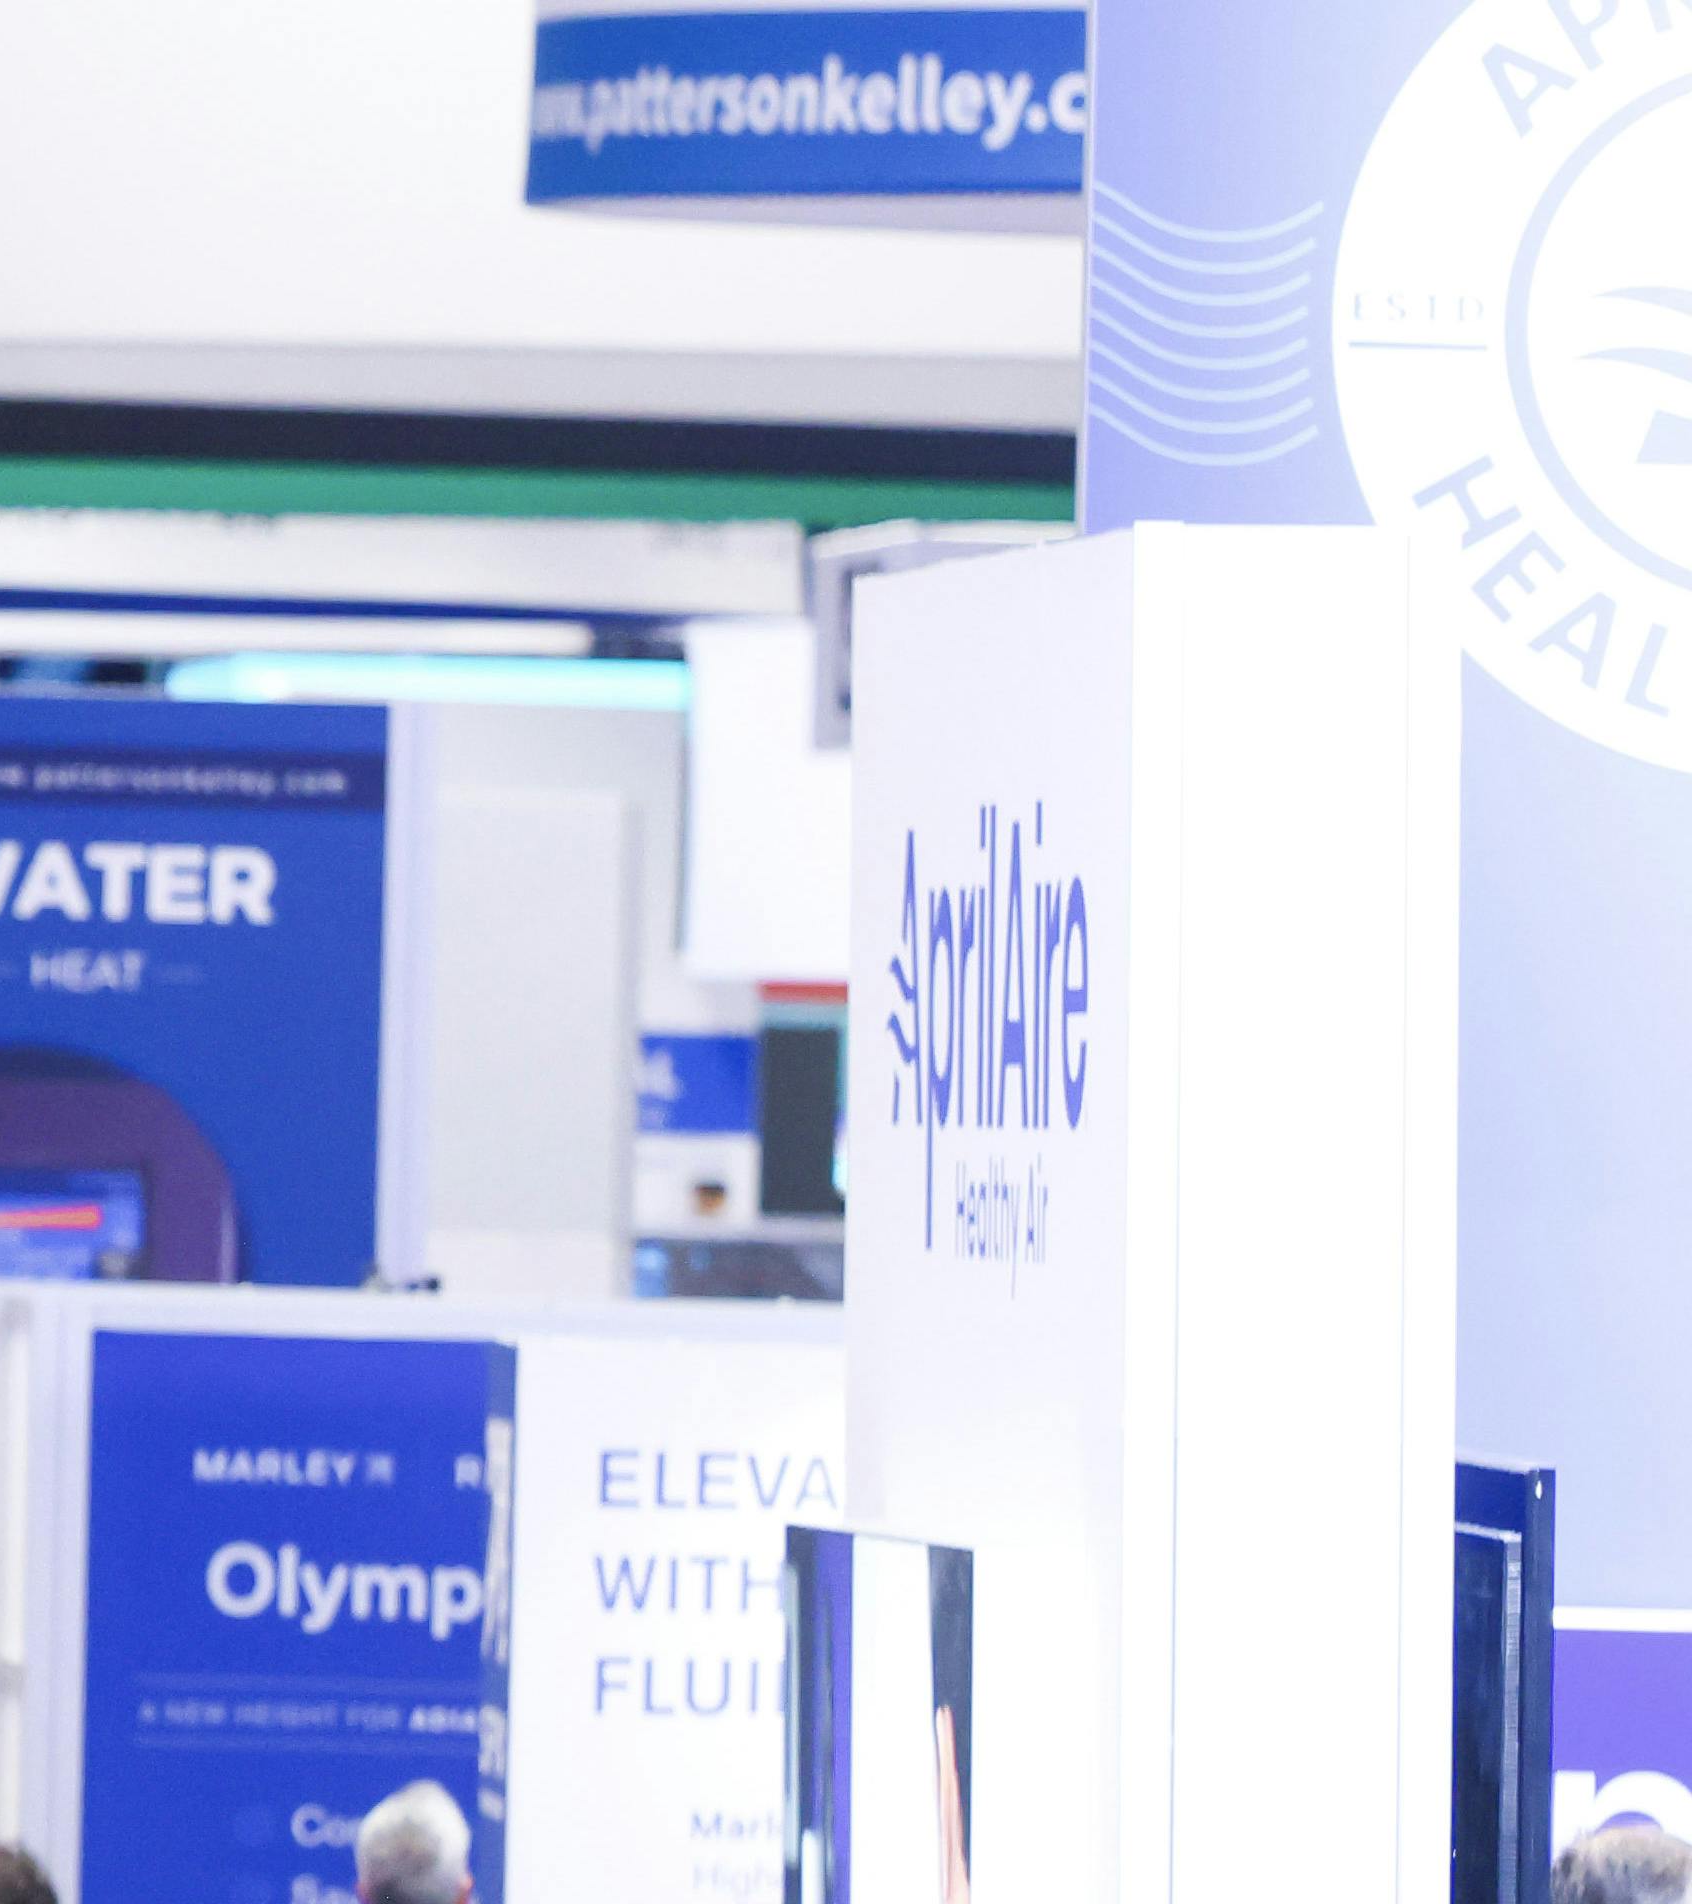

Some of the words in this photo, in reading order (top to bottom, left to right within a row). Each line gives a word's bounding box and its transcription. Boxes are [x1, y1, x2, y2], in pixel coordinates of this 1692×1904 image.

[31, 950, 143, 992] HEAT
[888, 800, 1088, 1250] AprilAire
[955, 1155, 1020, 1300] Healthy
[1026, 1153, 1049, 1262] Air
[193, 1449, 355, 1486] MARLEY
[206, 1540, 485, 1642] Olymp
